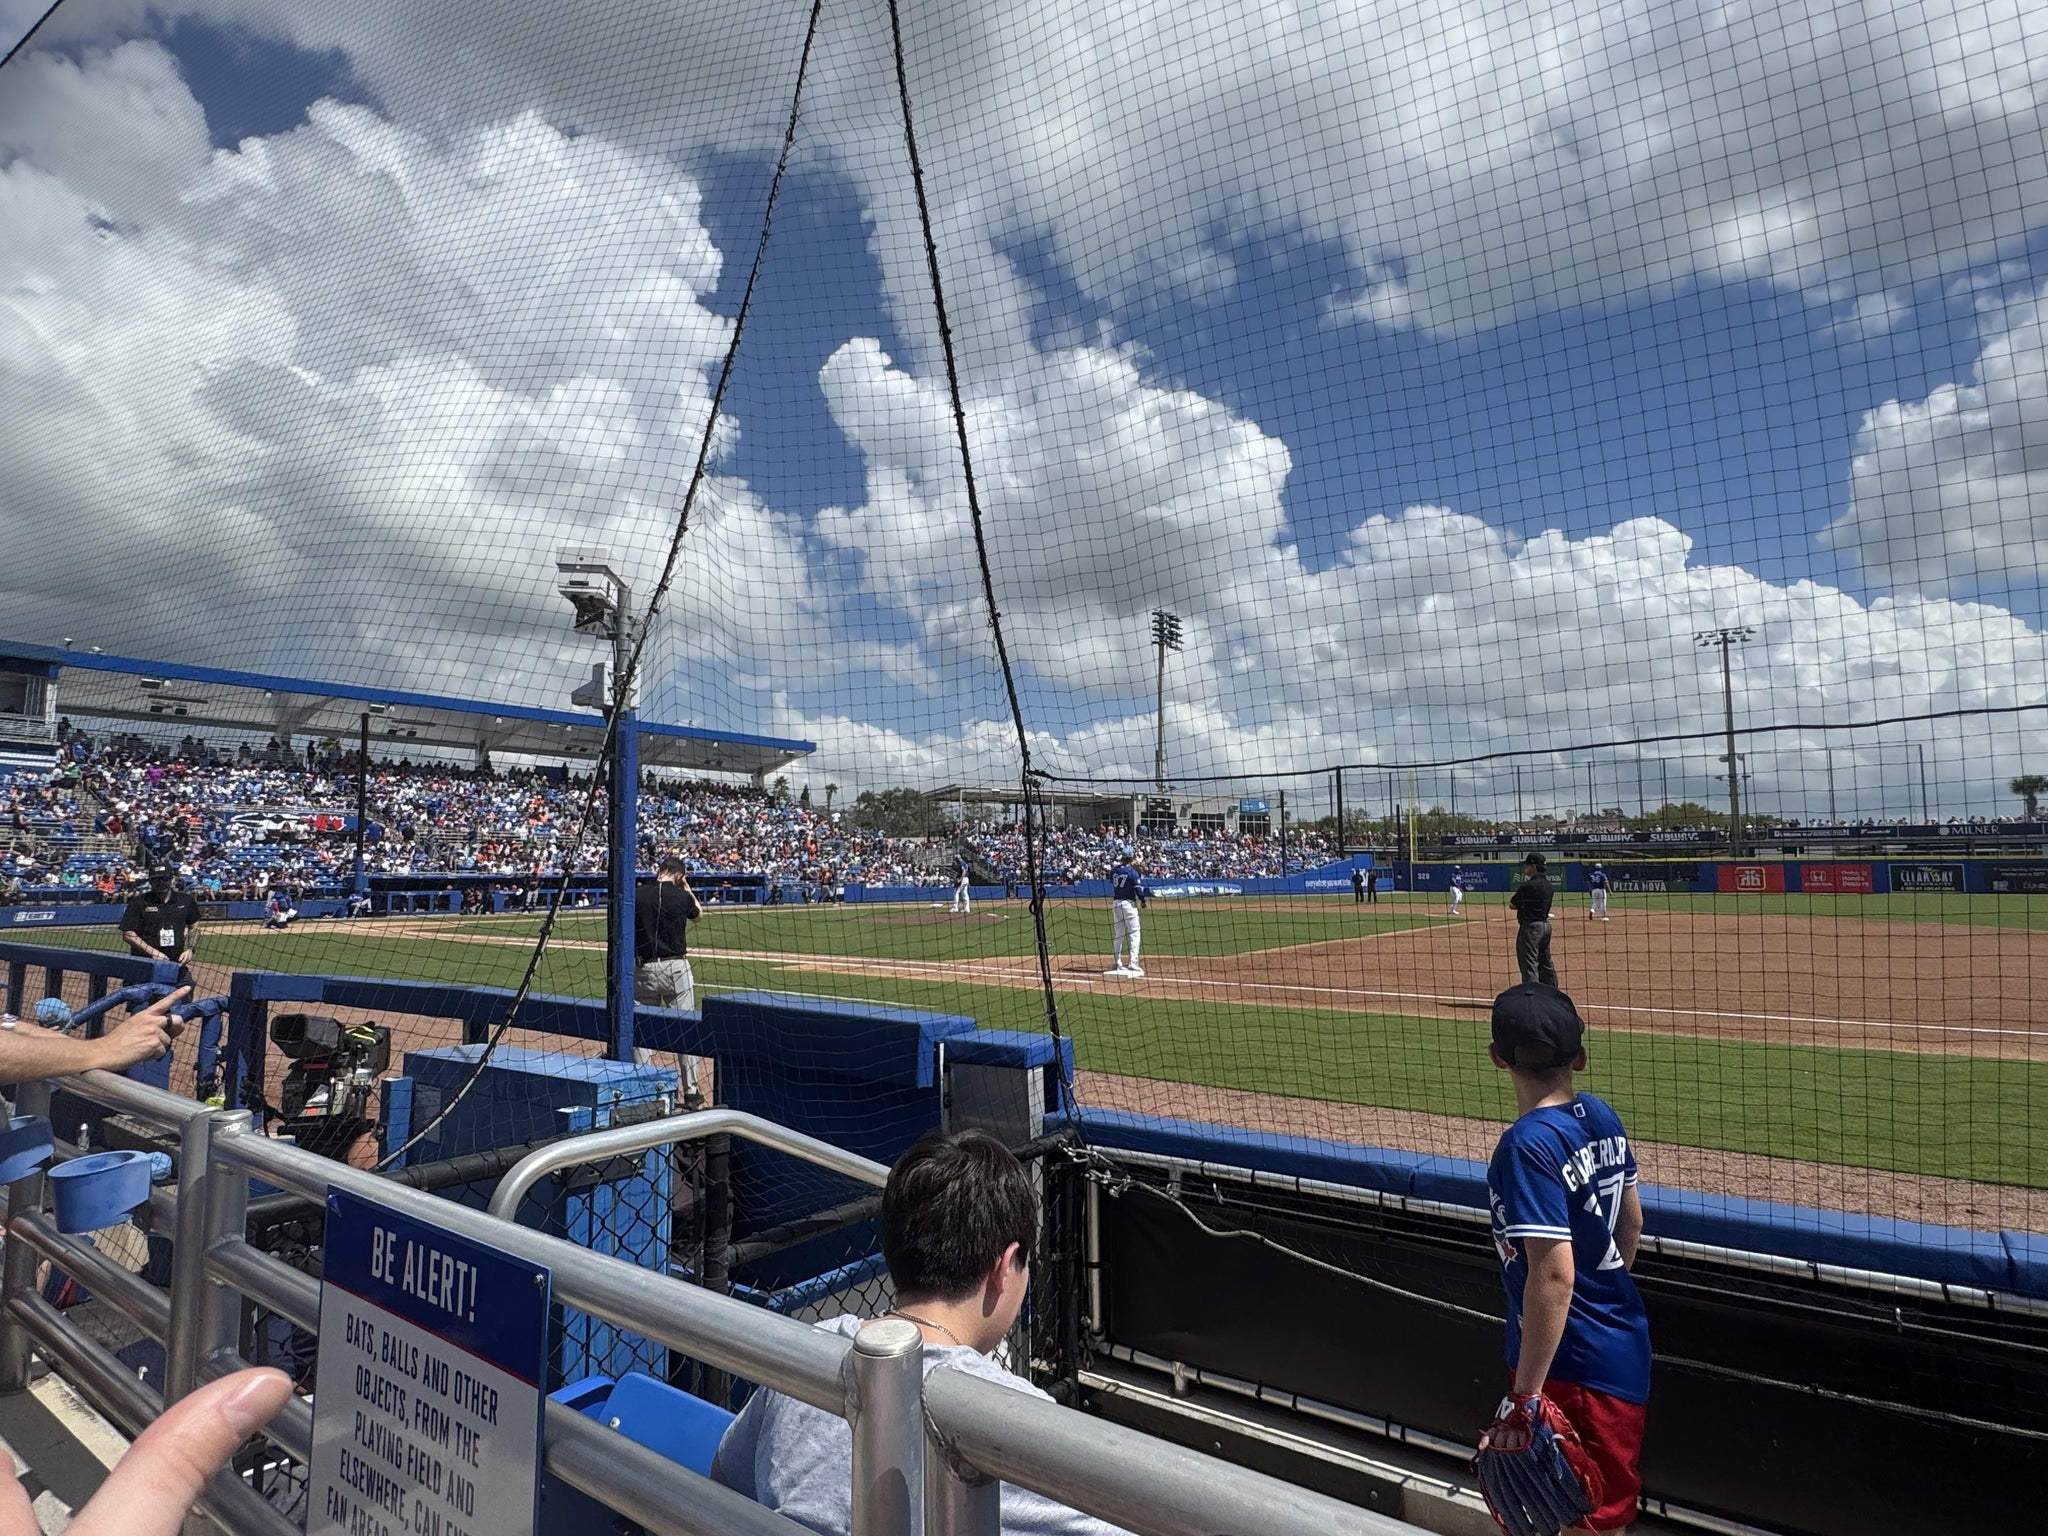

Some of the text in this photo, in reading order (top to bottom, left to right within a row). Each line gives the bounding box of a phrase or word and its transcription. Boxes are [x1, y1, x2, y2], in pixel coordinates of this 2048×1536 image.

[1454, 836, 1498, 845] SUBWAY
[1511, 835, 1556, 844] SUBWAY
[1586, 834, 1634, 843] SUBWAY
[1649, 832, 1700, 842] SUBWAY
[1951, 825, 2000, 835] MILNER
[1613, 882, 1667, 891] PIZZA NOVA
[371, 1226, 478, 1323] BE ALERT!
[346, 1313, 498, 1426] BATS, BALLS AND OTHER
[355, 1364, 480, 1468] OBJECTS, FROM THE
[354, 1410, 475, 1518] PLAYING FIELD AND
[339, 1448, 440, 1536] ELSEWHERE, CAN
[327, 1485, 348, 1528] FAN
